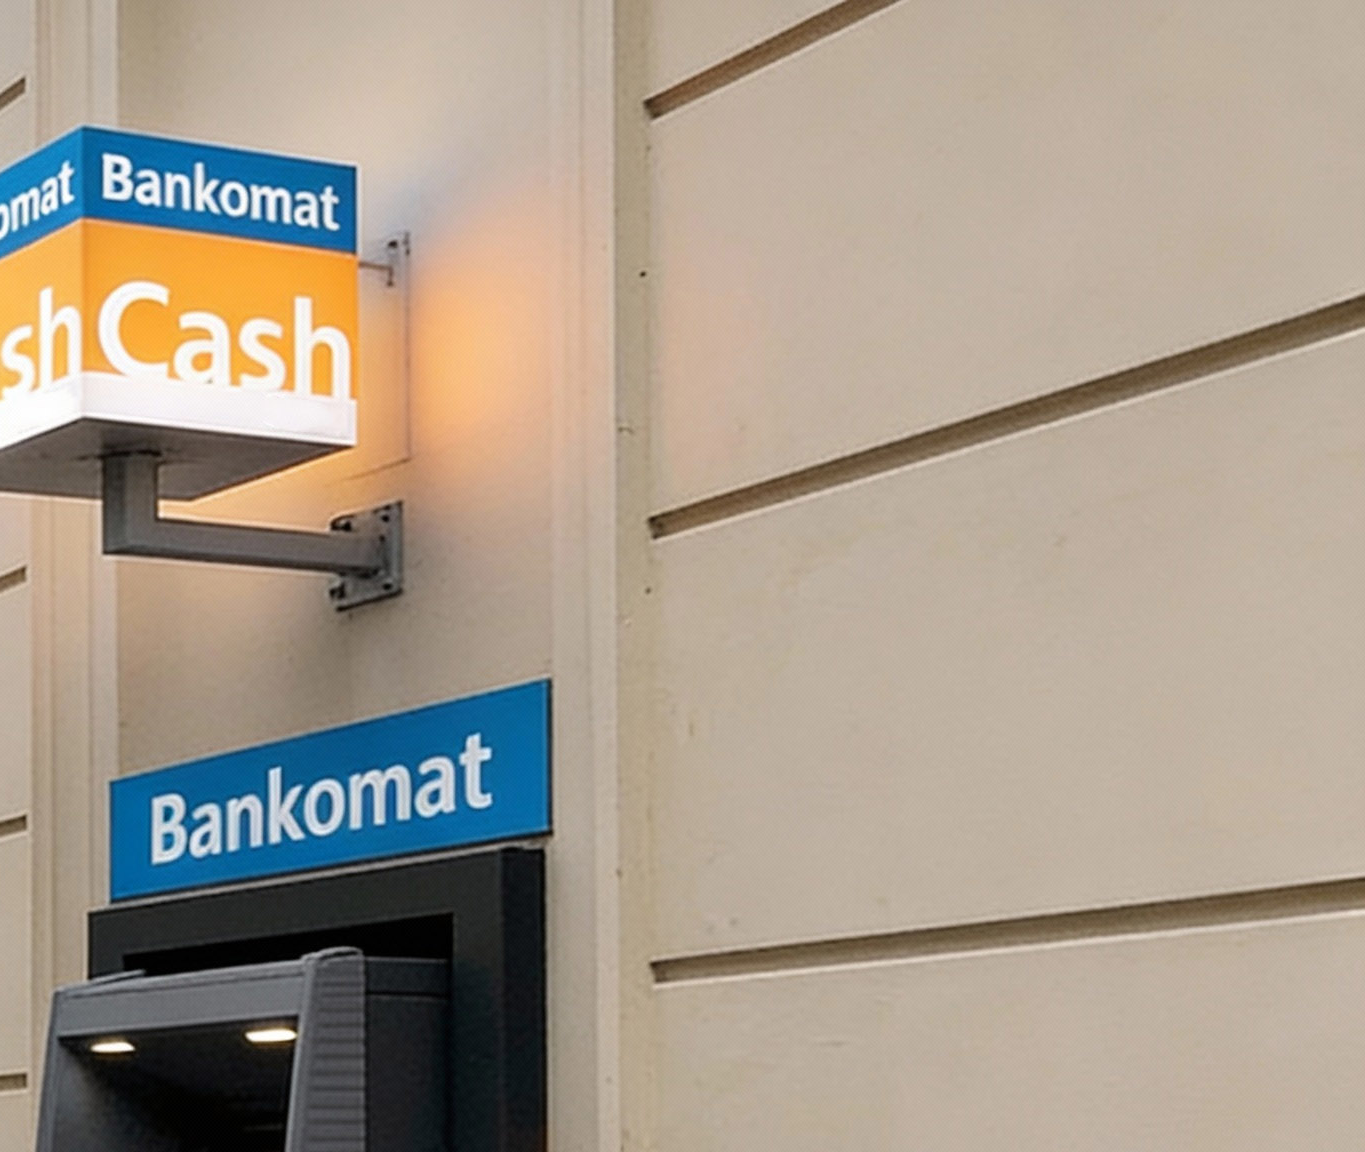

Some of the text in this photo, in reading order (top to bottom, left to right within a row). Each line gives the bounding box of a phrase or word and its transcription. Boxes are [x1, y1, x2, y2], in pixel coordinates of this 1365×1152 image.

[101, 152, 340, 231] Bankomat
[97, 280, 352, 399] Cash
[150, 732, 494, 865] Bankomat
